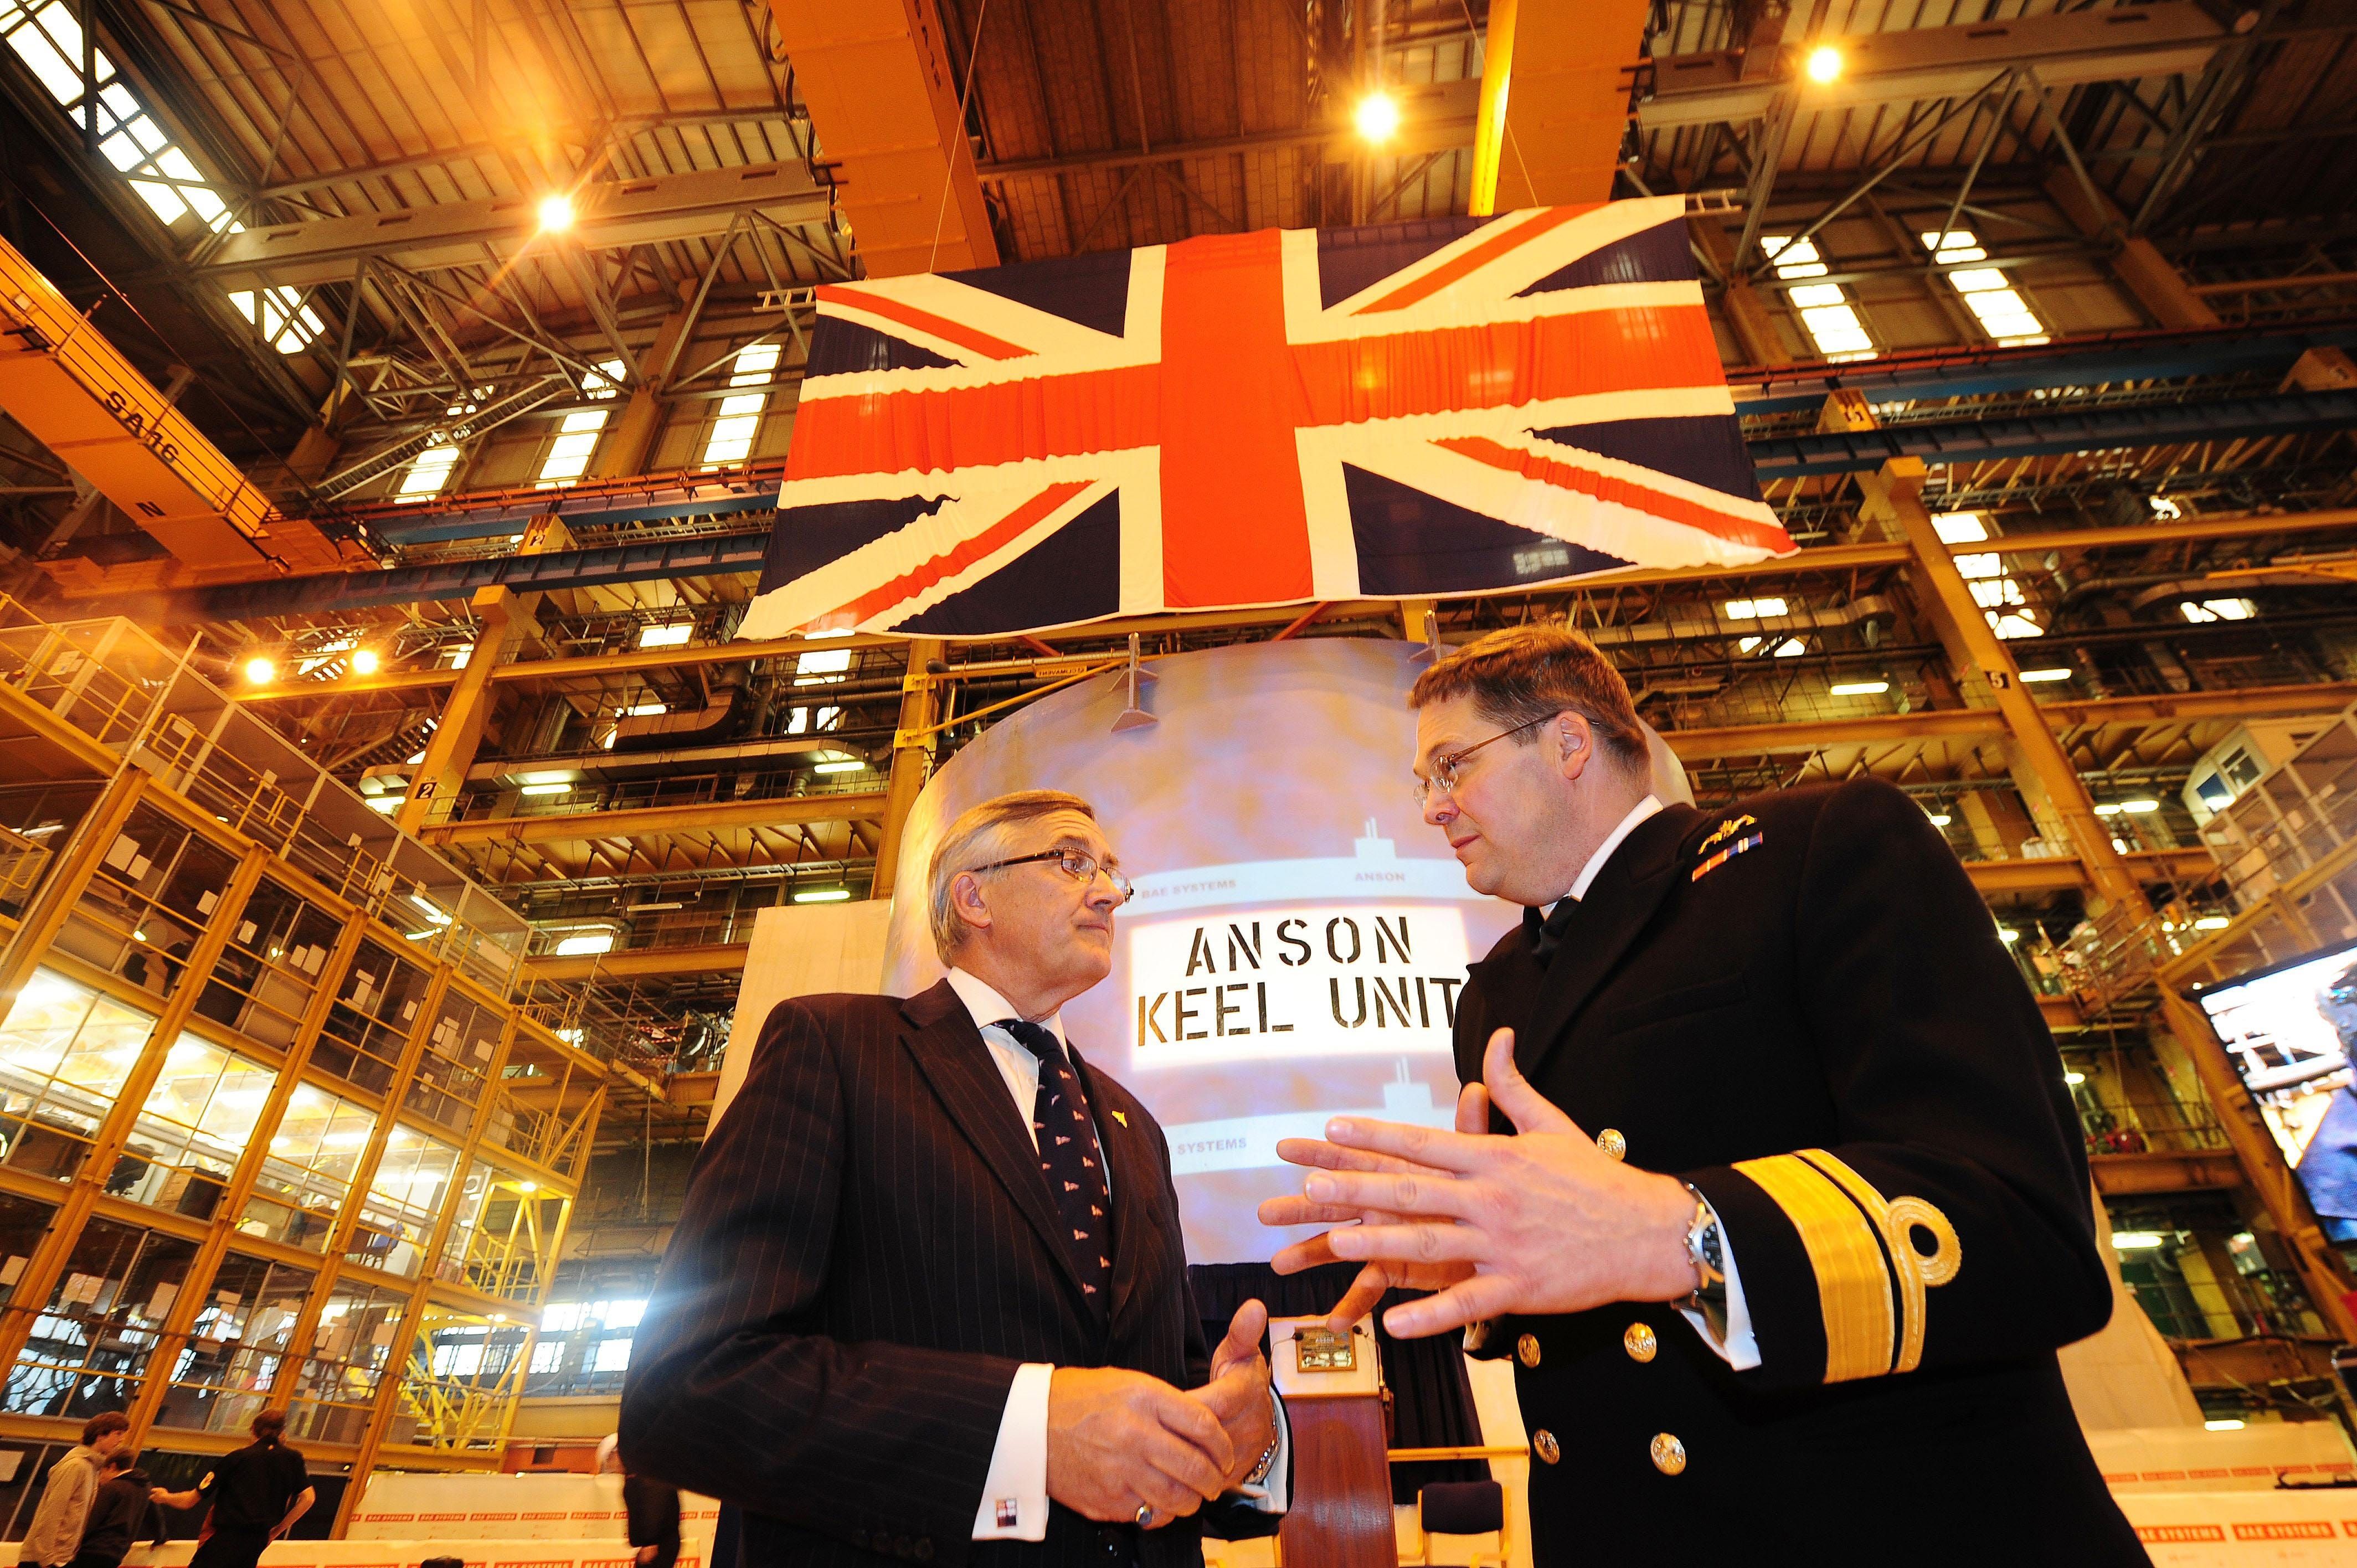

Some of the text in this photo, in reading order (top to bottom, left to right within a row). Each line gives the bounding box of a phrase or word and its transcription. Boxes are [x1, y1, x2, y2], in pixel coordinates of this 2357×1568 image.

[106, 390, 179, 463] SA16
[1991, 672, 2004, 688] 5
[419, 783, 433, 799] 2
[1355, 871, 1406, 882] ANSON
[1142, 880, 1236, 899] BAE SYSTEMS
[1186, 916, 1412, 977] ANSON
[1138, 976, 1462, 1046] KEEL UNIT
[1177, 1137, 1247, 1155] SYSTEMS
